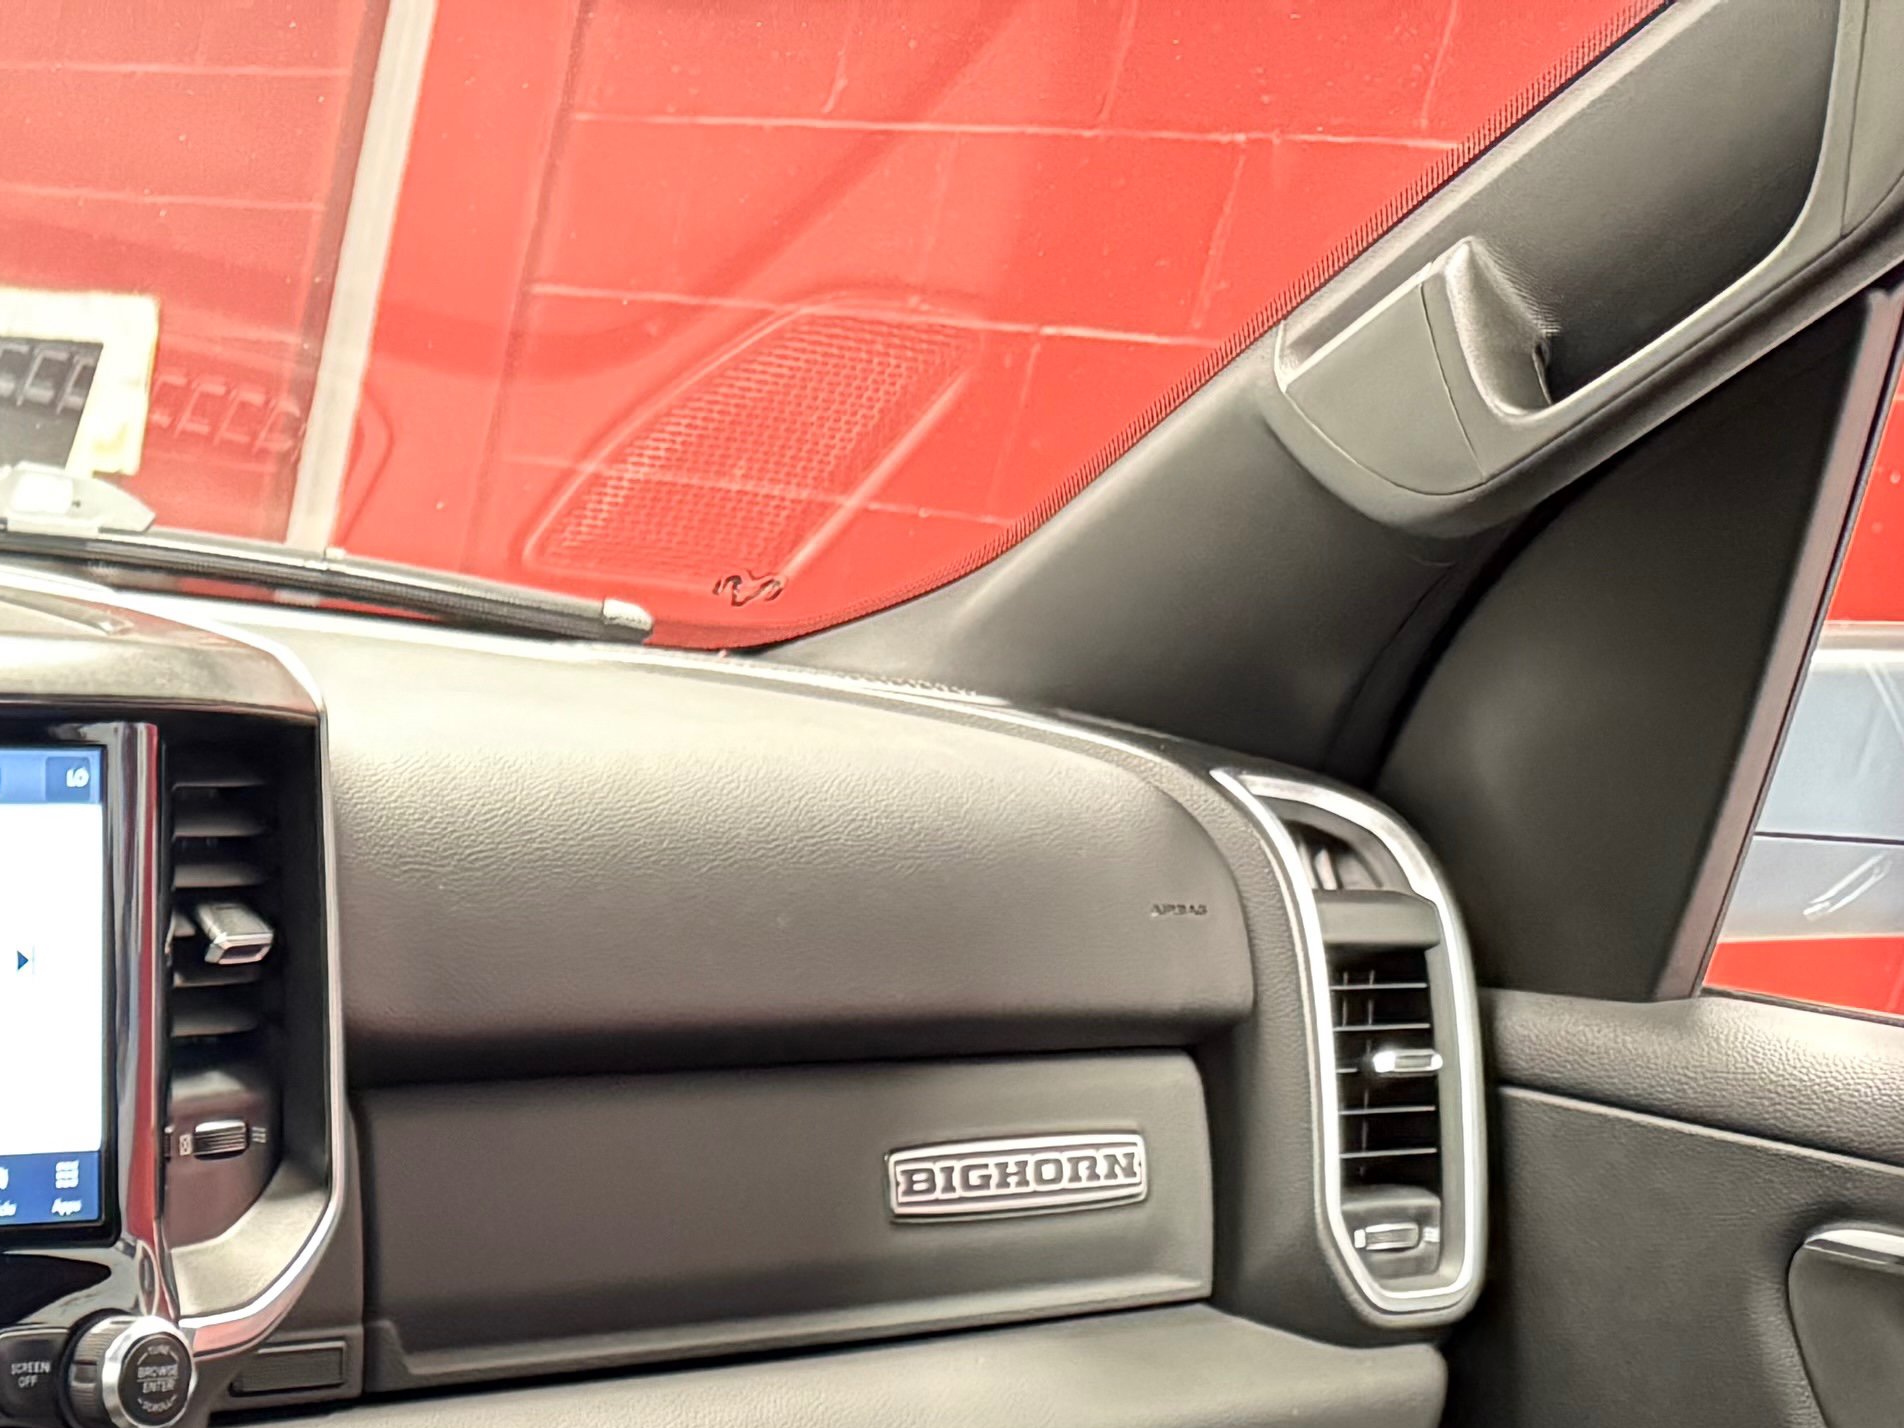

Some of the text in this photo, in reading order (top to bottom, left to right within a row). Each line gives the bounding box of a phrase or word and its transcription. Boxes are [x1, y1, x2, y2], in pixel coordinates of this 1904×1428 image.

[898, 1146, 1138, 1203] BIGHORN
[11, 1360, 52, 1375] SCREEN
[137, 1364, 179, 1379] BROWSE
[18, 1375, 38, 1388] OFF
[142, 1379, 176, 1393] ENTER
